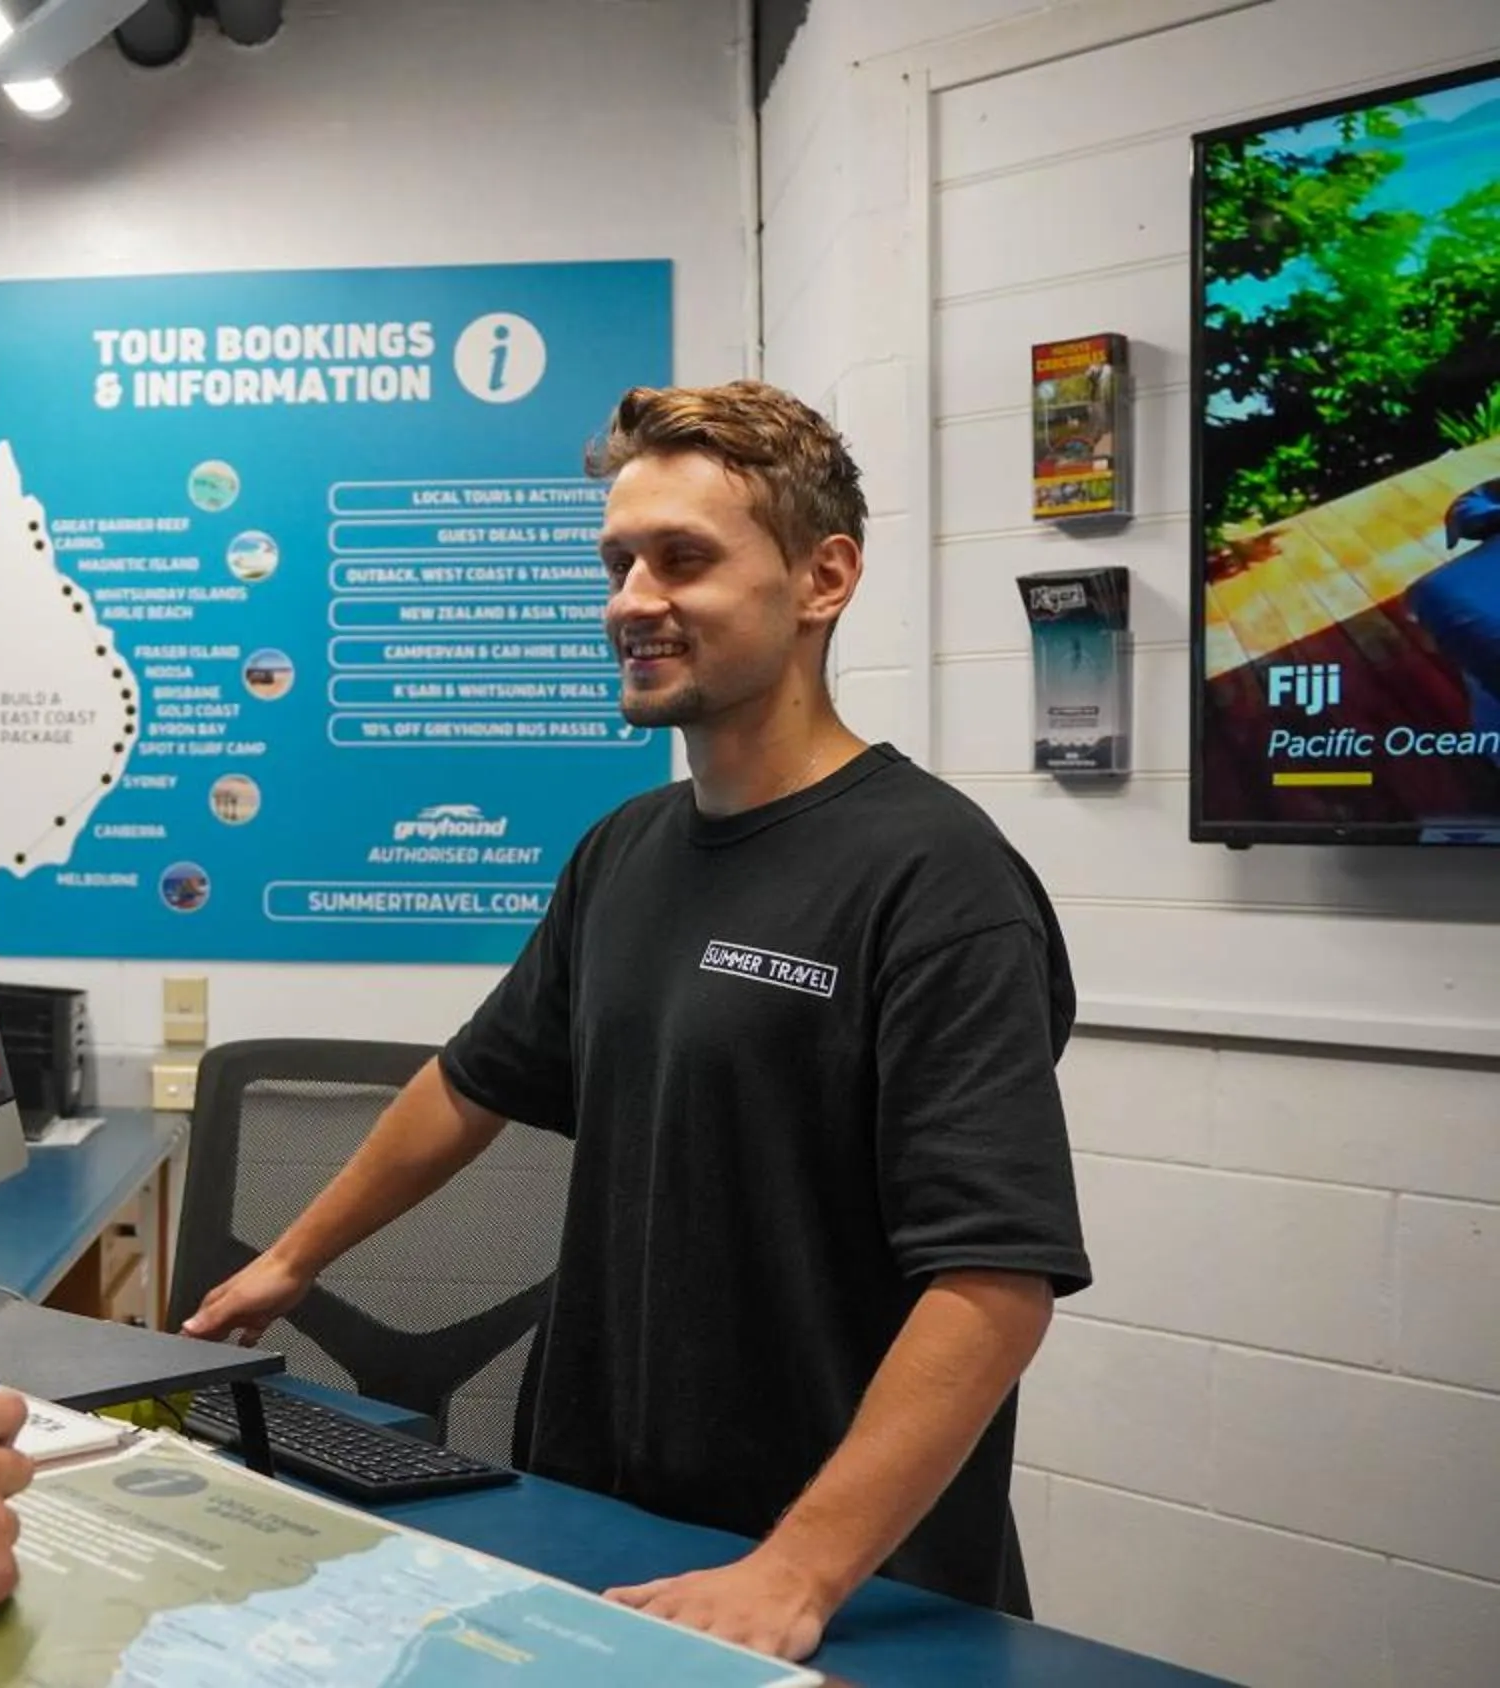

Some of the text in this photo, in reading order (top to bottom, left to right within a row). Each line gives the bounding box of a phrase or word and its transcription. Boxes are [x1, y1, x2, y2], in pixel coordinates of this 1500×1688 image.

[94, 322, 435, 365] TOUR BOOKINGS
[94, 365, 431, 409] & INFORMATION
[413, 490, 459, 505] LOCAL
[462, 489, 512, 504] TOURS
[515, 489, 525, 503] &
[51, 517, 190, 532] GREAT BARRIER REEF
[437, 527, 601, 543] GUEST DEALS & OFFER
[54, 537, 105, 550] CAIRNS
[77, 556, 199, 571] MAGNETIC ISLAND
[421, 567, 463, 582] WEST
[466, 567, 514, 581] COAST
[517, 567, 527, 581] &
[531, 566, 608, 580] TASMANIA
[95, 586, 248, 601] WHITSUNDAY ISLANDS
[103, 606, 193, 620] AIRLIE BEACH
[401, 607, 435, 621] NEW
[438, 606, 505, 620] ZEALAND
[508, 606, 518, 620] &
[521, 605, 556, 619] ASIA
[134, 645, 240, 659] FRASER ISLAND
[384, 644, 608, 660] CAMPERVAN & CAR HIRE DEALS
[144, 665, 194, 679] NOOSA
[153, 685, 221, 700] BRISBANE
[393, 683, 608, 698] K'GARI & WHITSUNDAY DEALS
[1268, 663, 1341, 716] Fiji
[1, 691, 62, 706] BUILD A
[1, 710, 97, 725] EAST COAST
[157, 703, 240, 717] GOLD COAST
[1, 729, 73, 744] PACKAGE
[148, 722, 226, 736] BYRON BAY
[361, 722, 607, 737] 10% OFF GREYHOUND BUS PASSES
[139, 742, 174, 756] SPOT
[225, 742, 266, 755] CAMP
[1267, 726, 1500, 758] Pacific Ocean
[123, 775, 177, 788] SYDNEY
[94, 825, 166, 838] CANBERRA
[393, 816, 508, 840] greyhound
[368, 847, 543, 864] AUTHORISED AGENT
[56, 873, 138, 887] MELBOURNE
[705, 946, 829, 990] SUMMER TRAVEL
